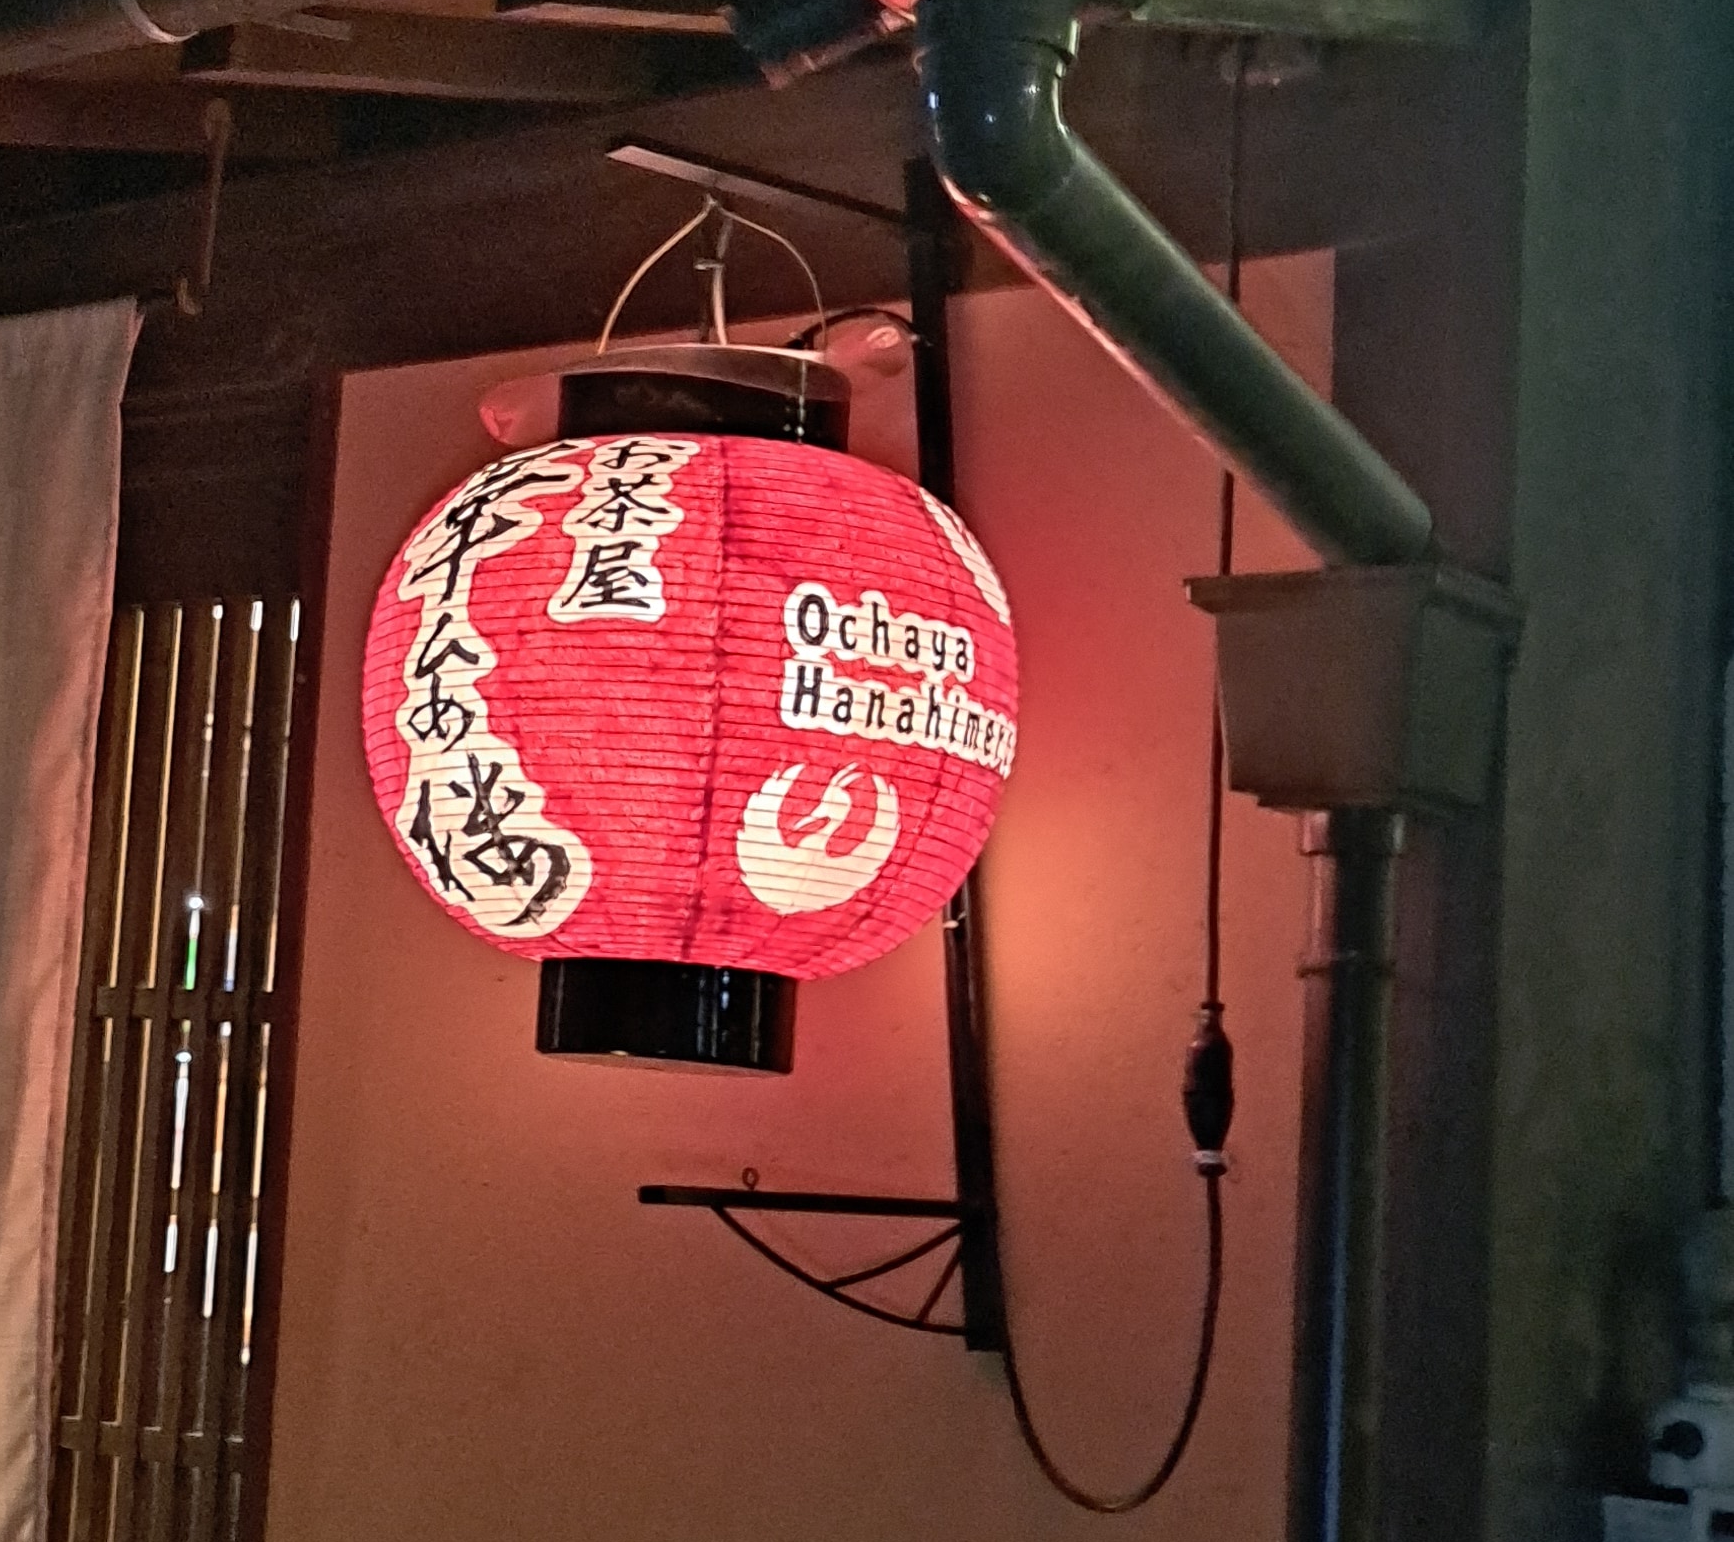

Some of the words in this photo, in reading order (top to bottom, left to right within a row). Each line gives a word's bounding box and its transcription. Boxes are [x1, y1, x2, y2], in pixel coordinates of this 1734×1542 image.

[560, 440, 689, 609] お茶屋
[797, 593, 967, 671] Ochaya
